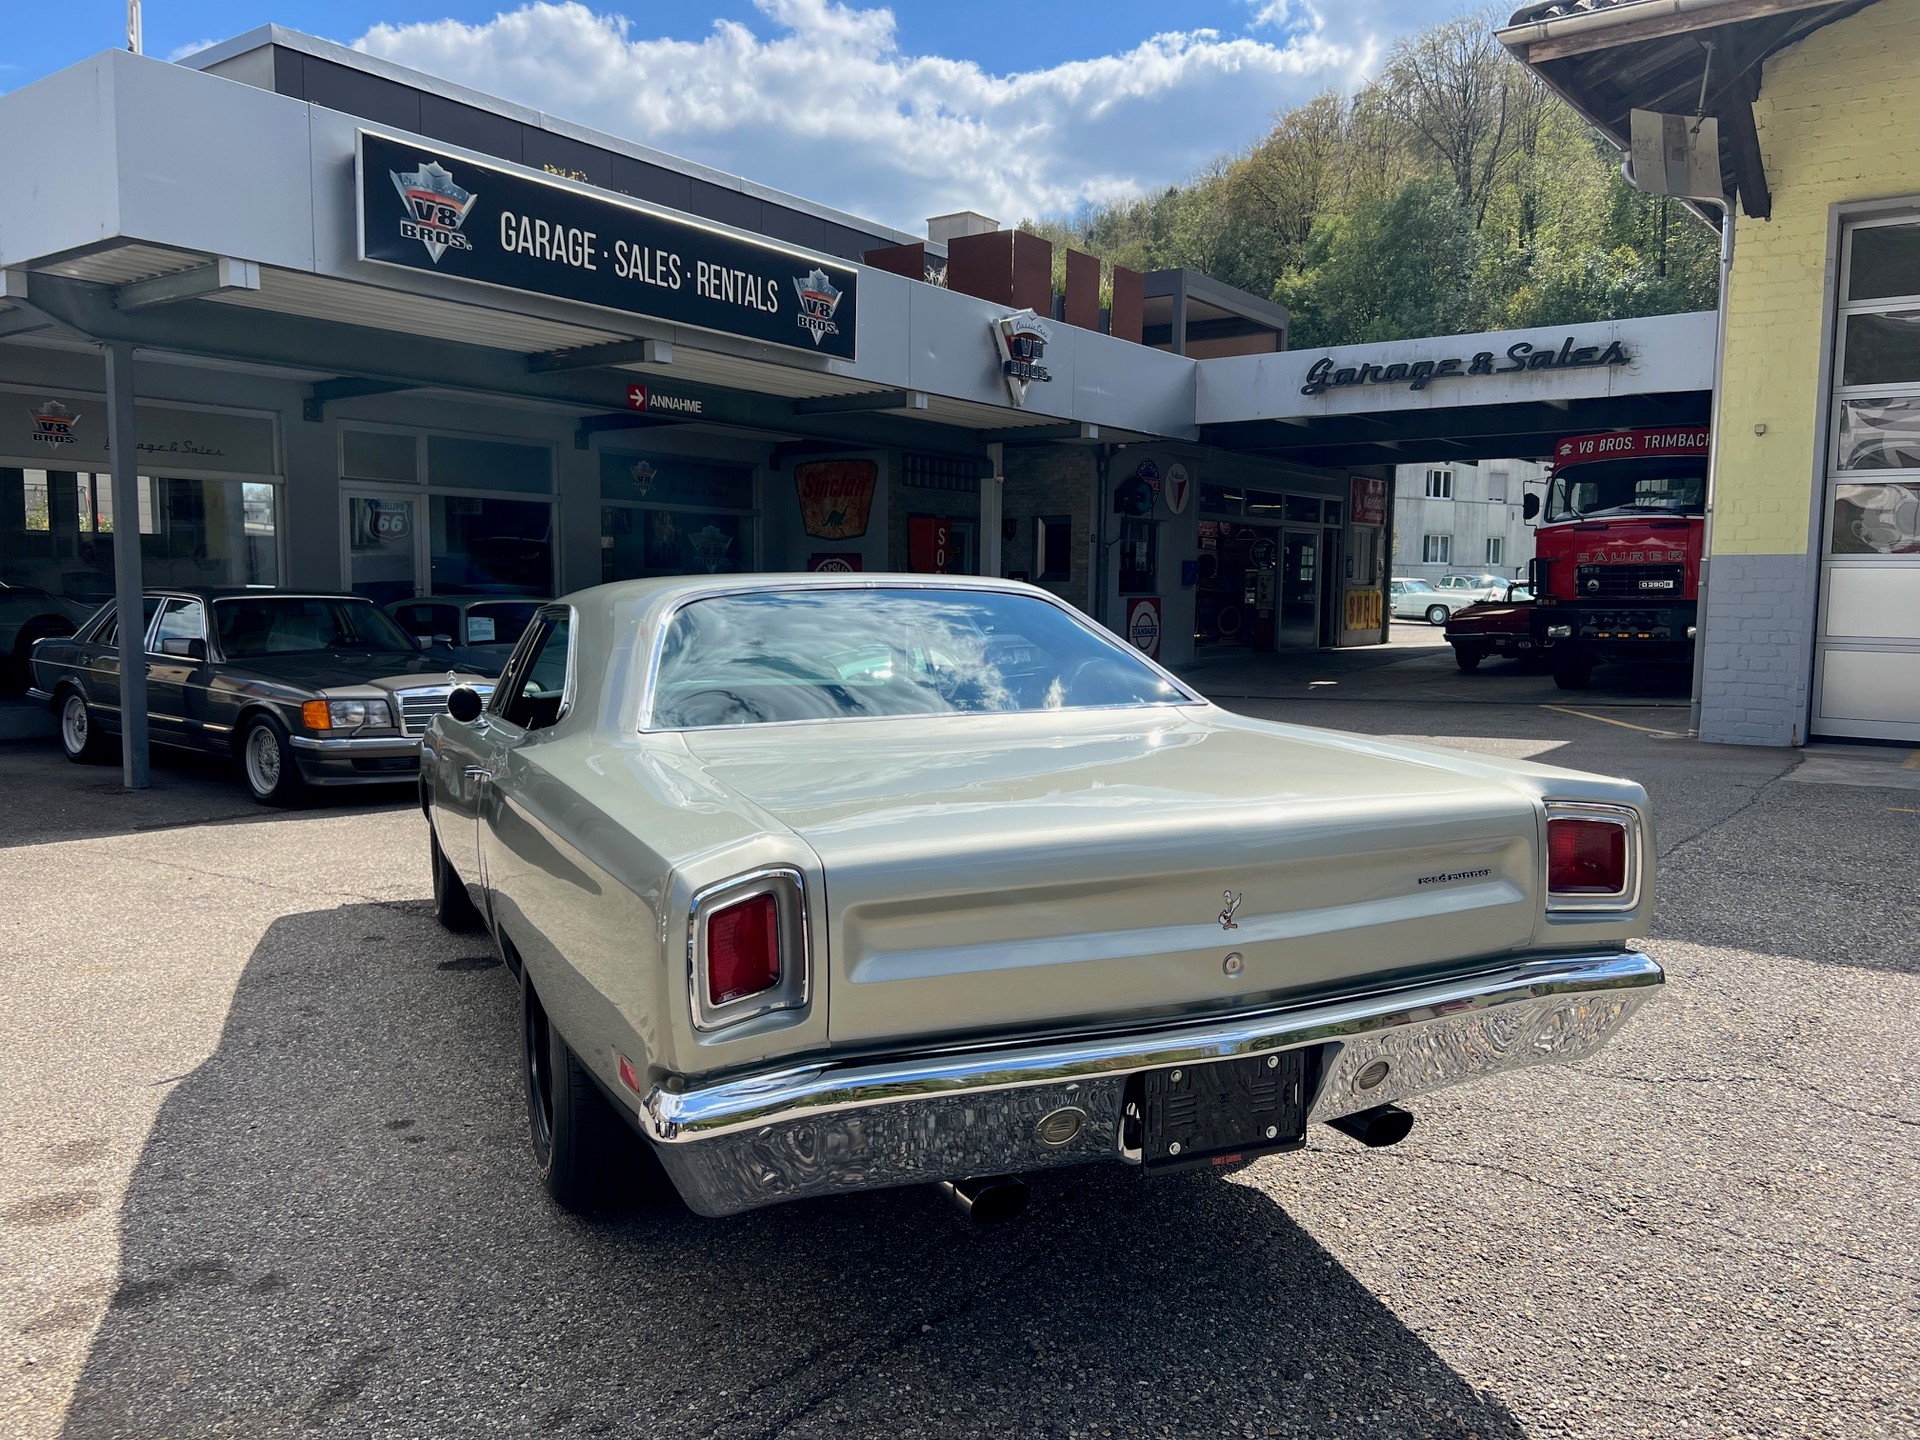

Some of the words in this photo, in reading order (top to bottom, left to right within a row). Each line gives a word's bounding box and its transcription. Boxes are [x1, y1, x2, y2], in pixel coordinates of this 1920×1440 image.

[412, 198, 459, 229] V8
[500, 211, 597, 271] GARAGE
[614, 240, 681, 290] SALES
[697, 260, 779, 313] RENTALS
[804, 297, 832, 319] V8
[1012, 337, 1044, 359] V8
[1300, 357, 1465, 396] Garage
[1468, 352, 1495, 376] &
[1496, 337, 1631, 373] Sales
[650, 394, 702, 413] ANNAHME
[41, 420, 69, 433] V8
[169, 442, 178, 453] &
[181, 440, 225, 456] Sales
[1579, 440, 1595, 454] V8
[1599, 436, 1635, 452] BROS.
[374, 501, 406, 511] PHILLIPS
[378, 515, 403, 532] 66
[1576, 550, 1683, 562] SAURER
[1350, 595, 1381, 624] SHELL
[1132, 627, 1158, 635] STANDARD
